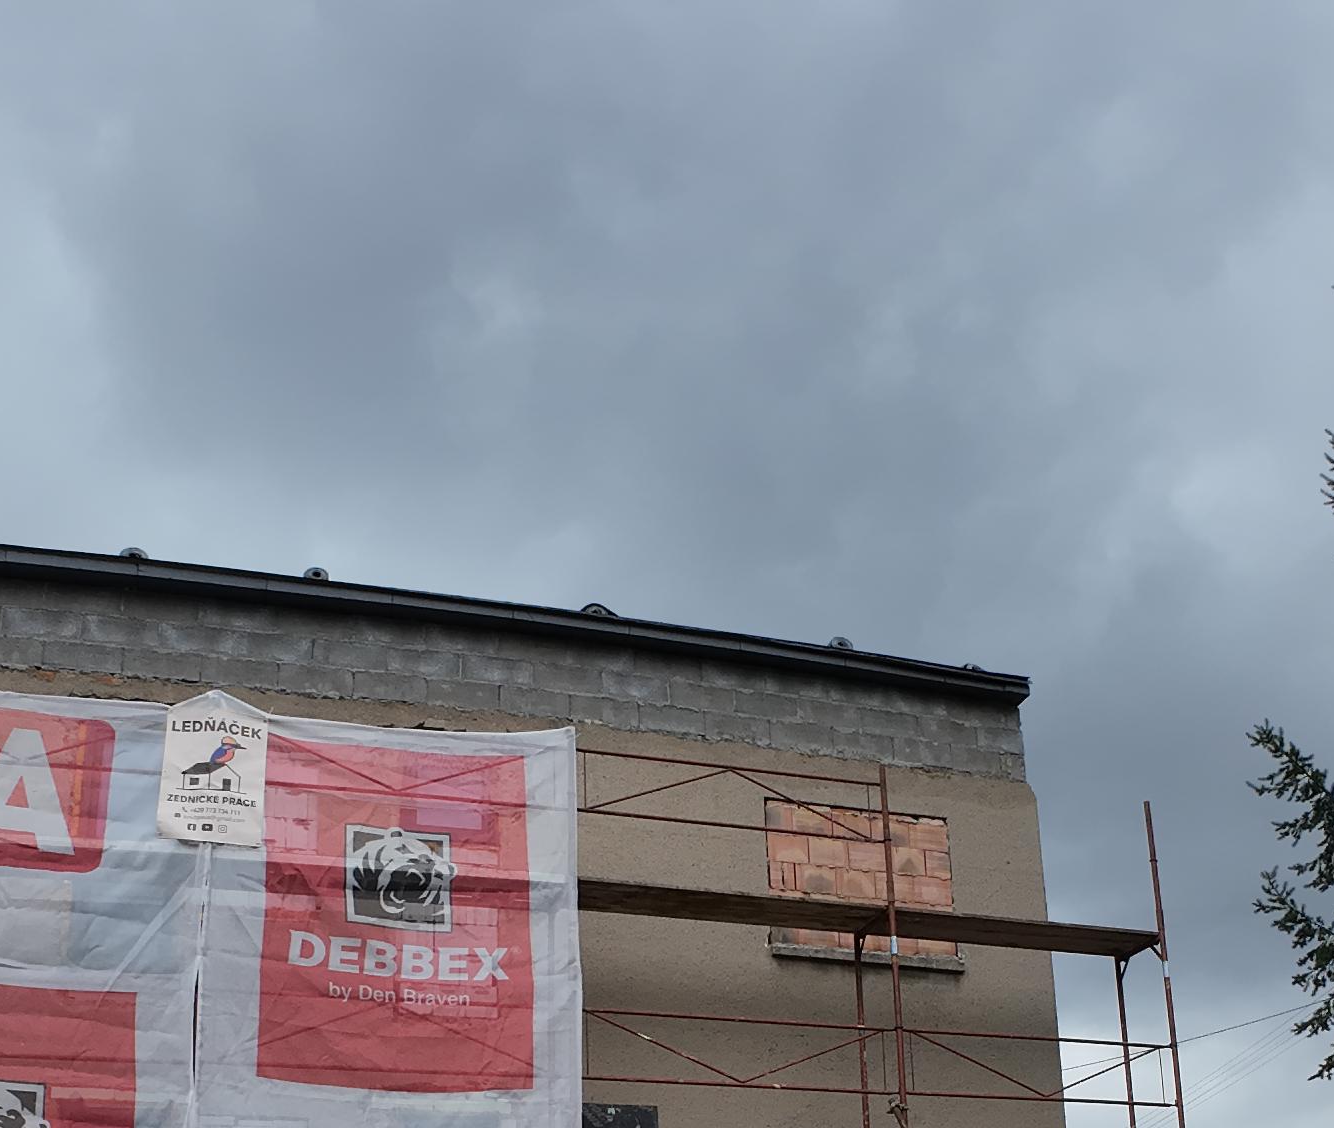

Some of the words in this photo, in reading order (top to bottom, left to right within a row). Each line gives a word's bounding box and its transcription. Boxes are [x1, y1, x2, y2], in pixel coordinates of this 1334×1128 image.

[171, 716, 262, 740] LEDŇÁČEK
[328, 982, 352, 1004] by
[359, 984, 396, 1003] Den
[403, 989, 471, 1007] Braven
